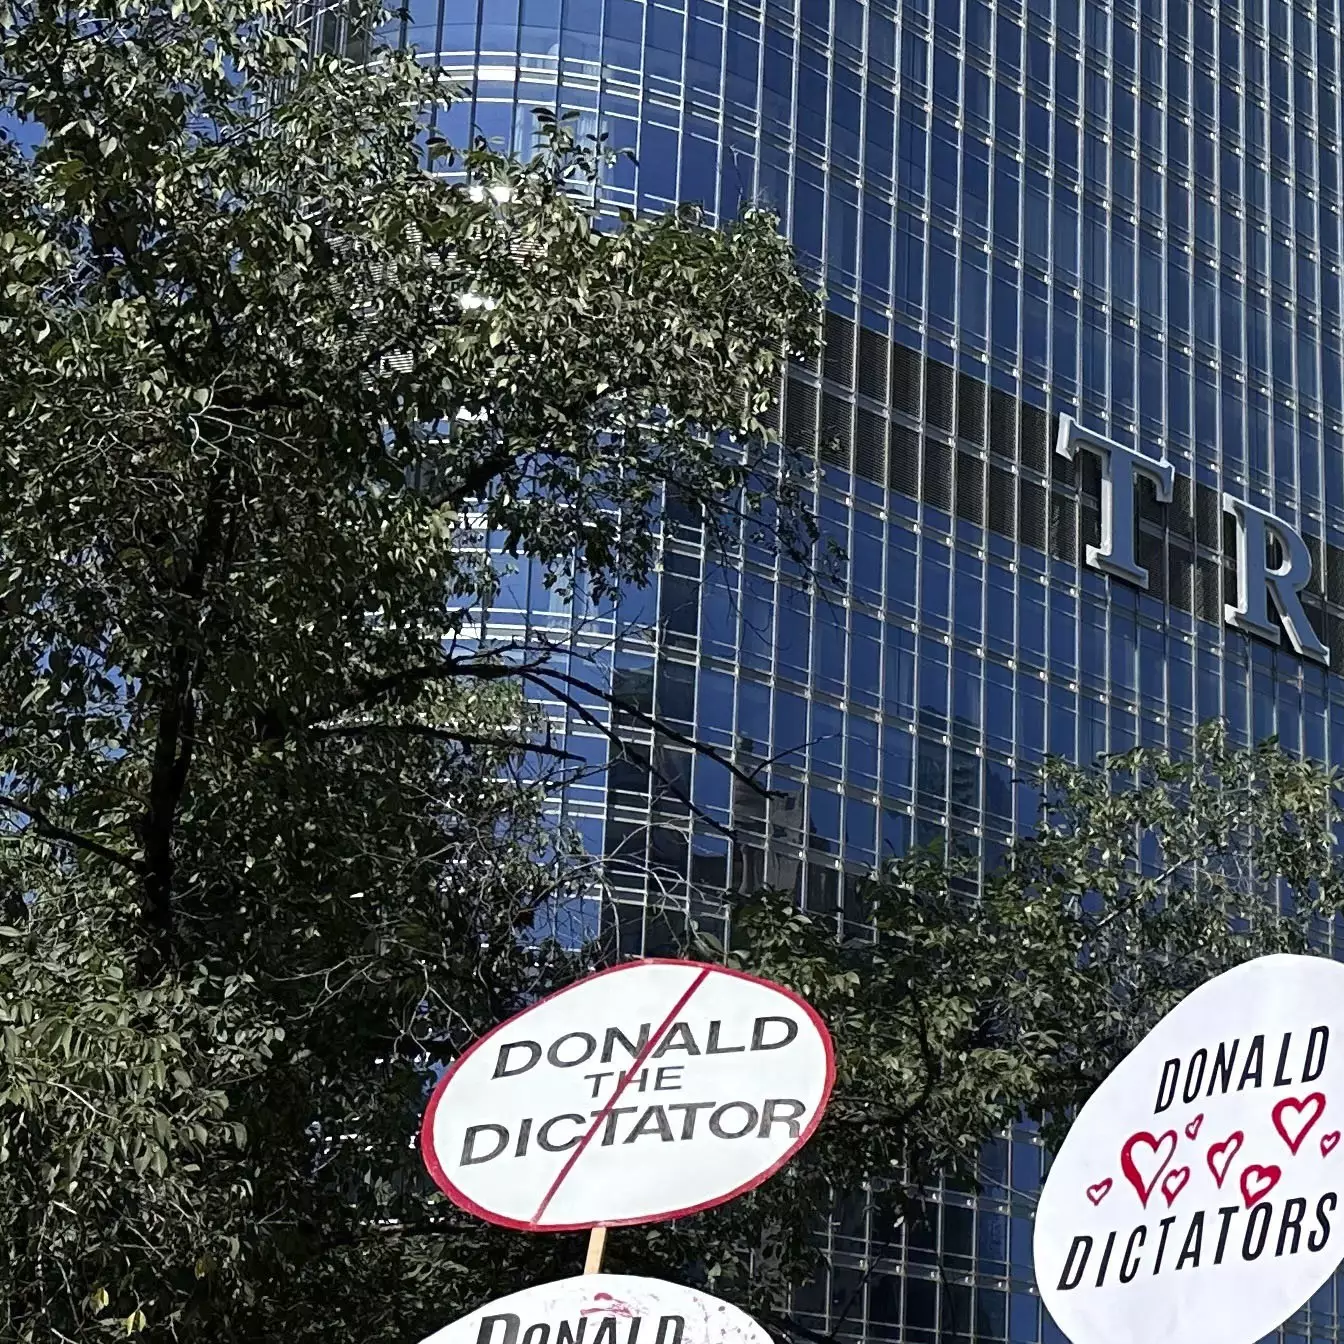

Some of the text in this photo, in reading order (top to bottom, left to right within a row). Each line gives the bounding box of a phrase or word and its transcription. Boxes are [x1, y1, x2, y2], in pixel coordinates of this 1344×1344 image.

[490, 1014, 799, 1080] DONALD
[583, 1064, 685, 1098] THE
[1155, 1024, 1330, 1114] DONALD
[459, 1098, 808, 1167] DICTATOR
[1057, 1191, 1340, 1292] DICTATORS
